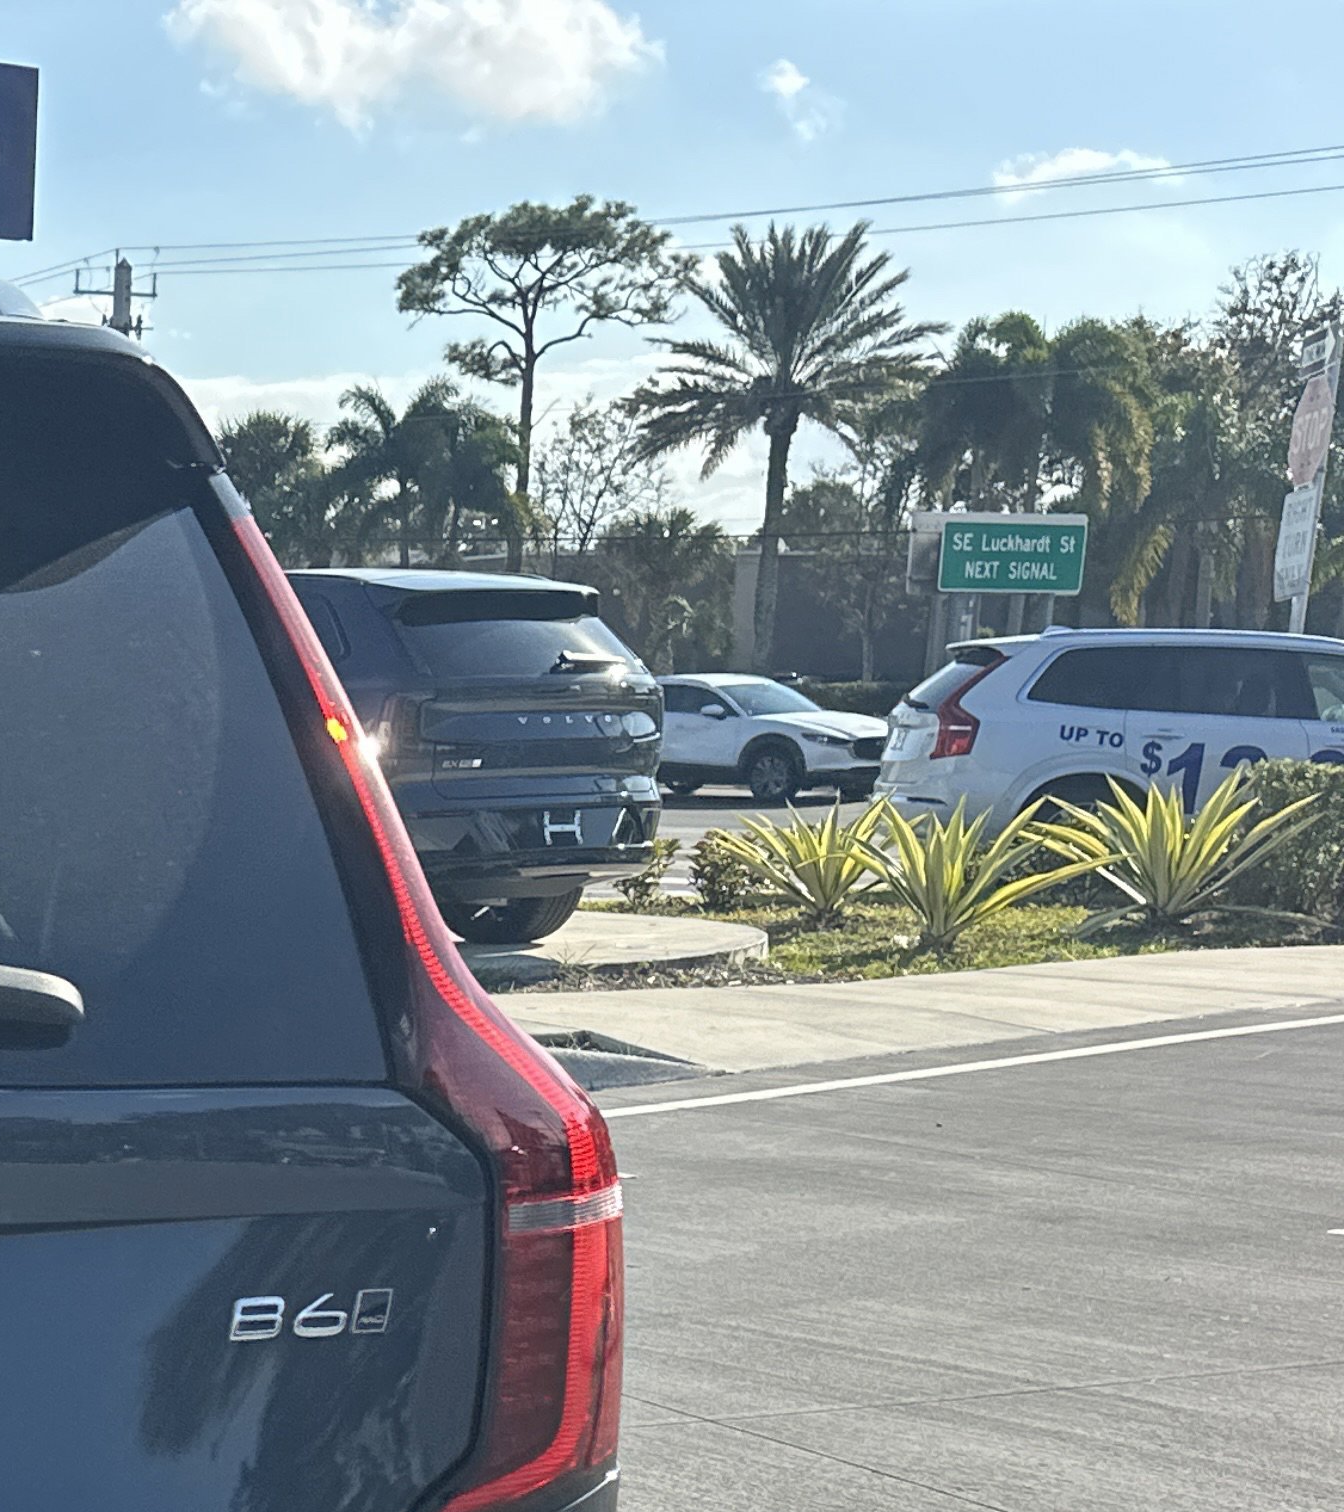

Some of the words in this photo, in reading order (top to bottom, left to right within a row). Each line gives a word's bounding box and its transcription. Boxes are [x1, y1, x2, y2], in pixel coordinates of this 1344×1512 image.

[1291, 407, 1329, 455] STOP
[952, 532, 974, 551] SE
[981, 533, 1051, 553] Luckhardt
[1059, 535, 1076, 553] St
[964, 560, 1000, 579] NEXT
[1008, 561, 1057, 580] SIGNAL
[518, 715, 612, 725] VOLVO
[1060, 724, 1089, 741] UP
[1096, 729, 1124, 748] TO
[229, 1293, 348, 1341] B6
